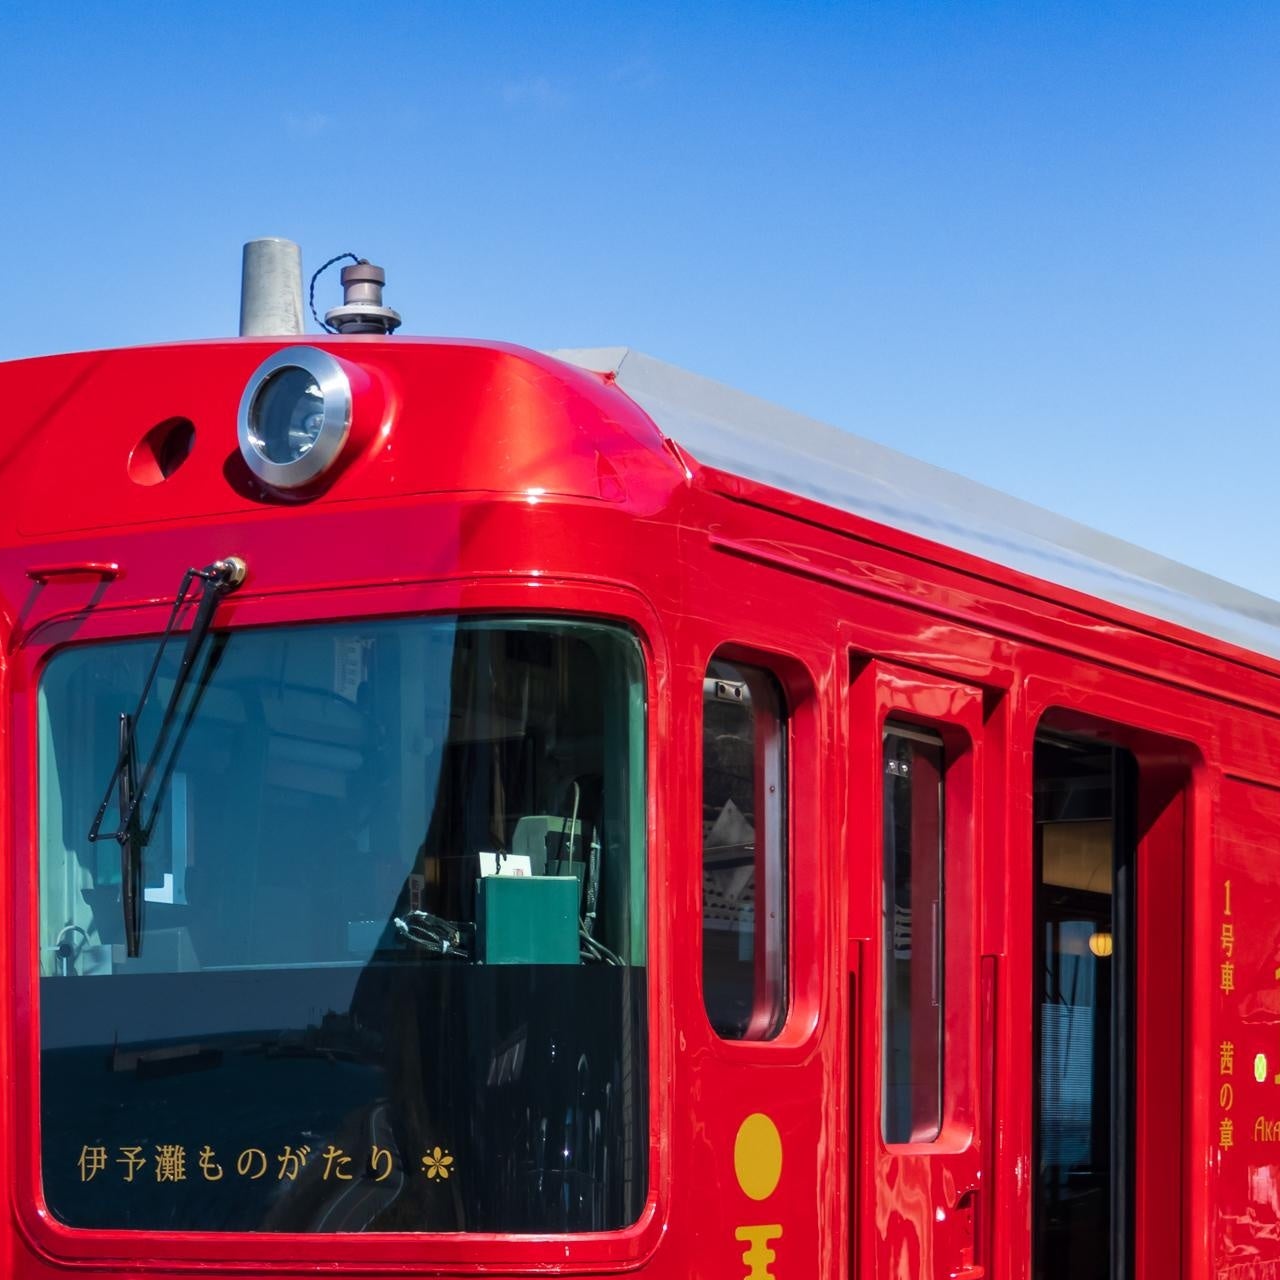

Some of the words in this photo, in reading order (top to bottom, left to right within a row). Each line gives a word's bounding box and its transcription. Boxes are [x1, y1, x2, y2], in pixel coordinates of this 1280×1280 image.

[1220, 880, 1234, 996] 1号車
[1219, 1041, 1234, 1152] 茜の章
[77, 1144, 393, 1183] 伊予灘ものがたり
